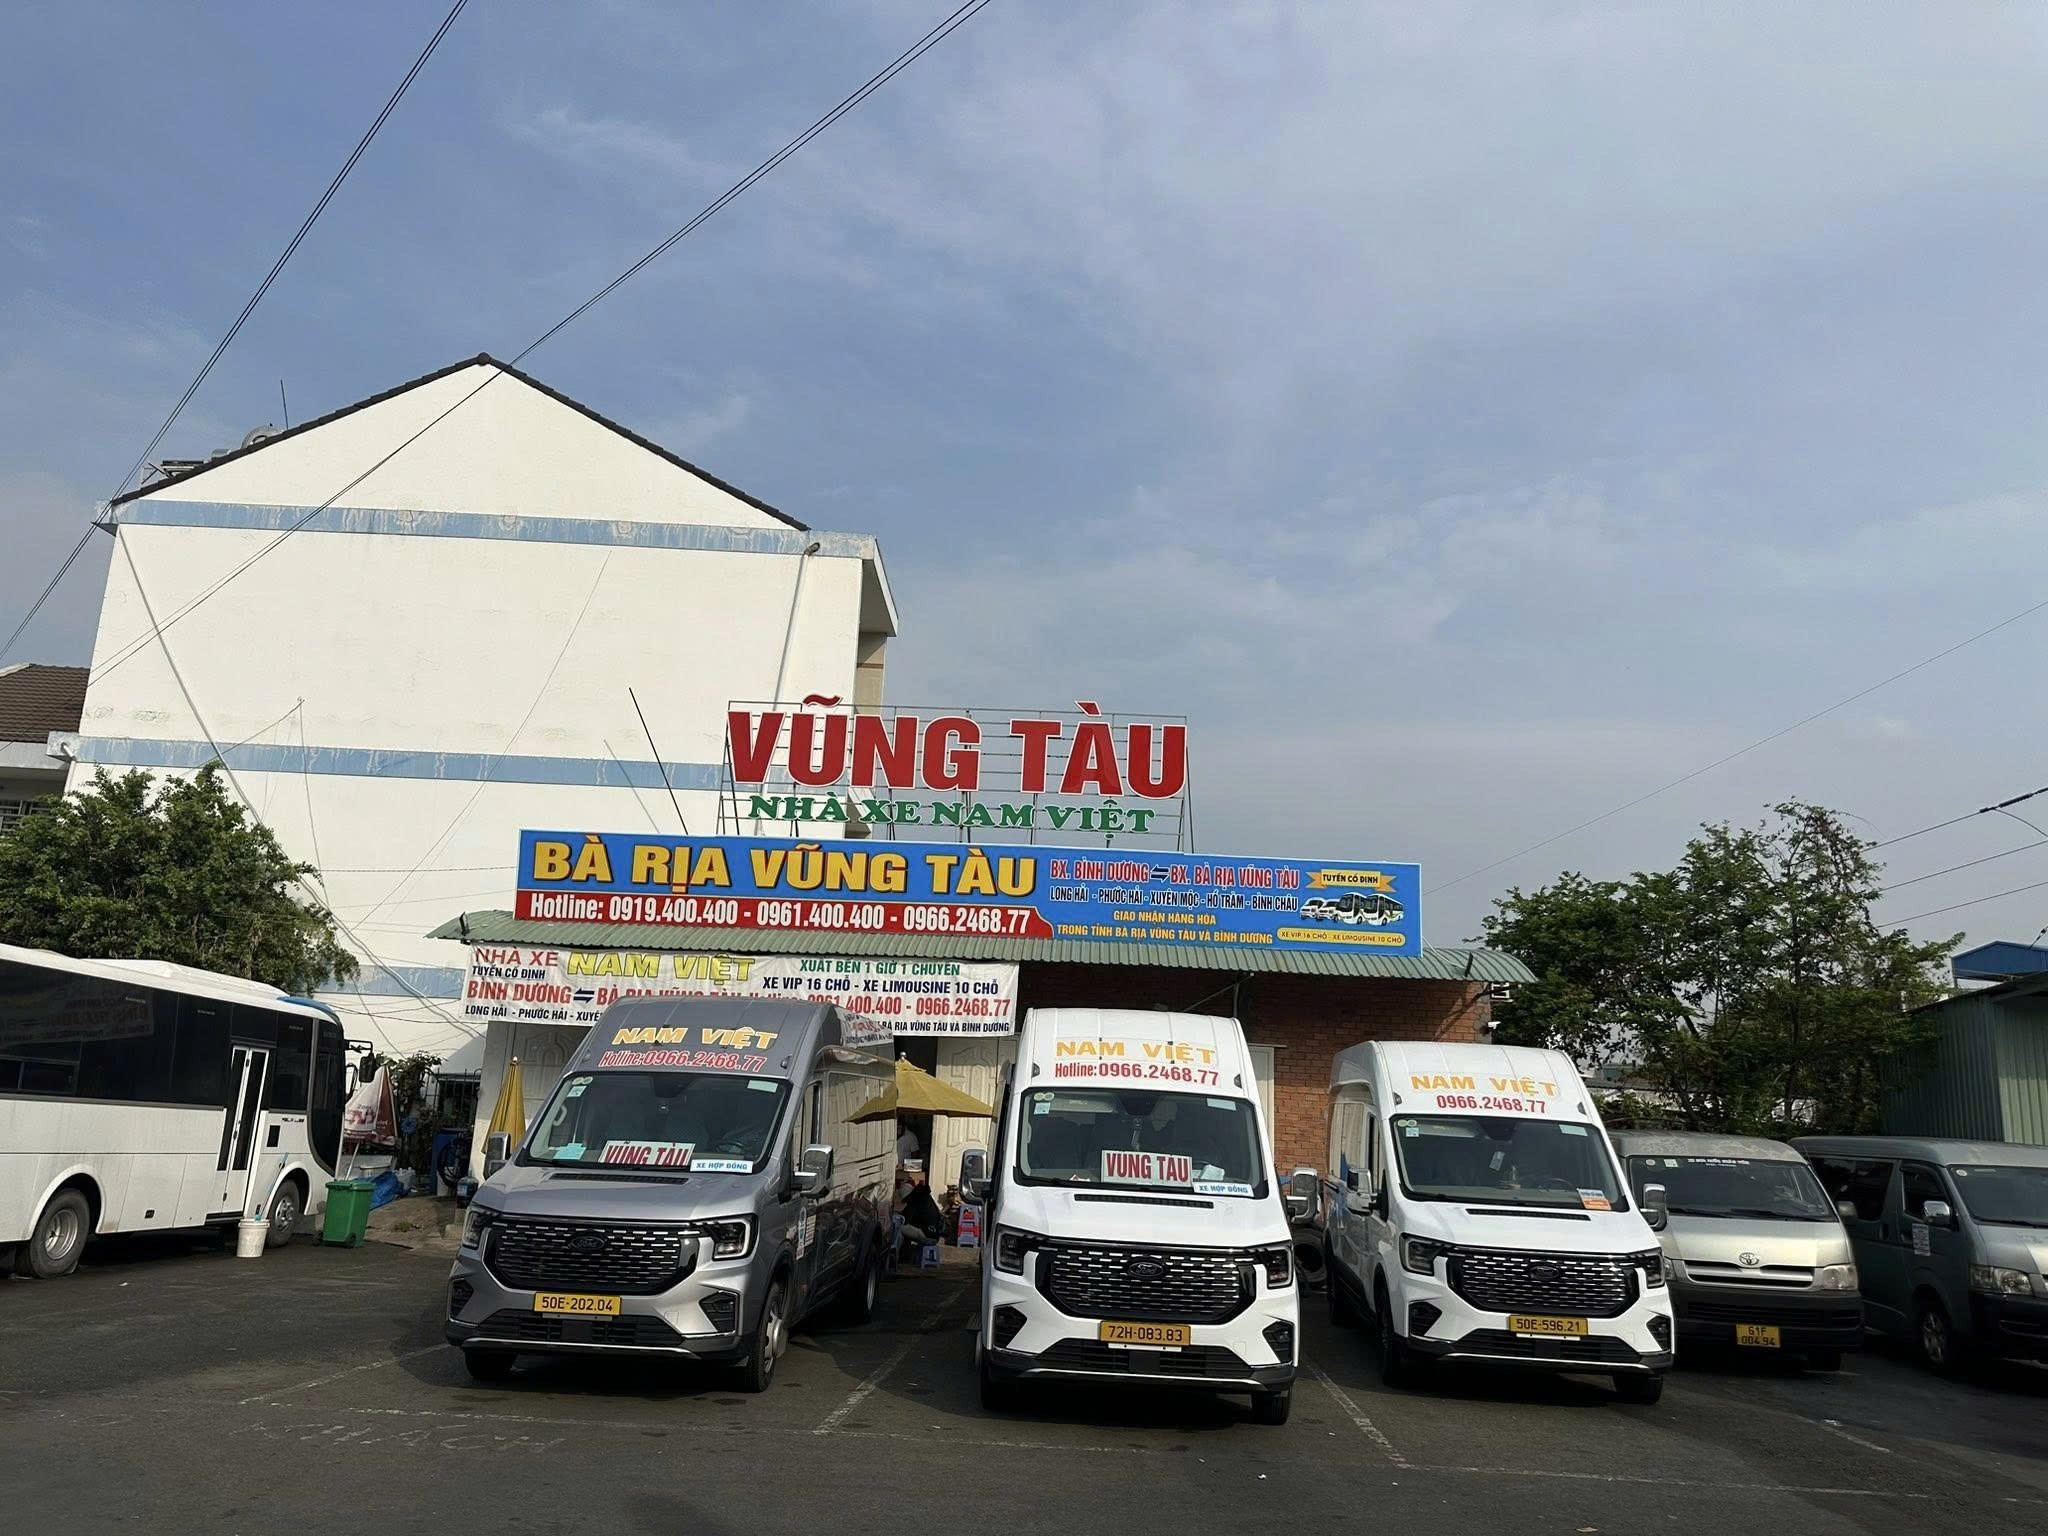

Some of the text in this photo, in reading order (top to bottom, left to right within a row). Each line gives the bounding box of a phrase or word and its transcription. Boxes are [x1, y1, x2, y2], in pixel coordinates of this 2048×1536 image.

[726, 693, 1187, 799] VŨNG TÀU
[748, 791, 1155, 839] NHÀ XE NAM VIỆT
[533, 834, 1036, 897] BÀ RỊA VŨNG TÀU
[1050, 885, 1073, 901] LONG
[529, 892, 603, 920] Hotline:
[608, 895, 738, 924] 0919.400.400
[757, 901, 884, 929] 0961.400.400
[903, 905, 1030, 934] 0966.2468.77
[1113, 910, 1136, 921] GIAO
[1056, 923, 1088, 937] TRONG
[475, 945, 756, 986] NHÀ XE NAM VIỆT
[467, 976, 508, 1001] BÌNH
[512, 982, 573, 1006] DƯƠNG
[763, 976, 779, 989] XE
[782, 976, 803, 990] VIP
[807, 978, 822, 991] 16
[863, 979, 878, 993] XE
[883, 980, 951, 994] LIMOUSINE
[954, 981, 969, 995] 10
[465, 1004, 489, 1017] LONG
[915, 997, 1011, 1017] 0966.2468.77
[612, 1026, 778, 1050] NAM VIỆT
[1056, 1040, 1216, 1064] NAM VIỆT
[1411, 1075, 1557, 1097] NAM VIỆT
[1436, 1094, 1546, 1114] 0966.2468.77
[541, 1296, 613, 1312] 50E-202.04
[1108, 1325, 1183, 1341] 72H-083.83
[1516, 1318, 1581, 1332] 50E-596.21
